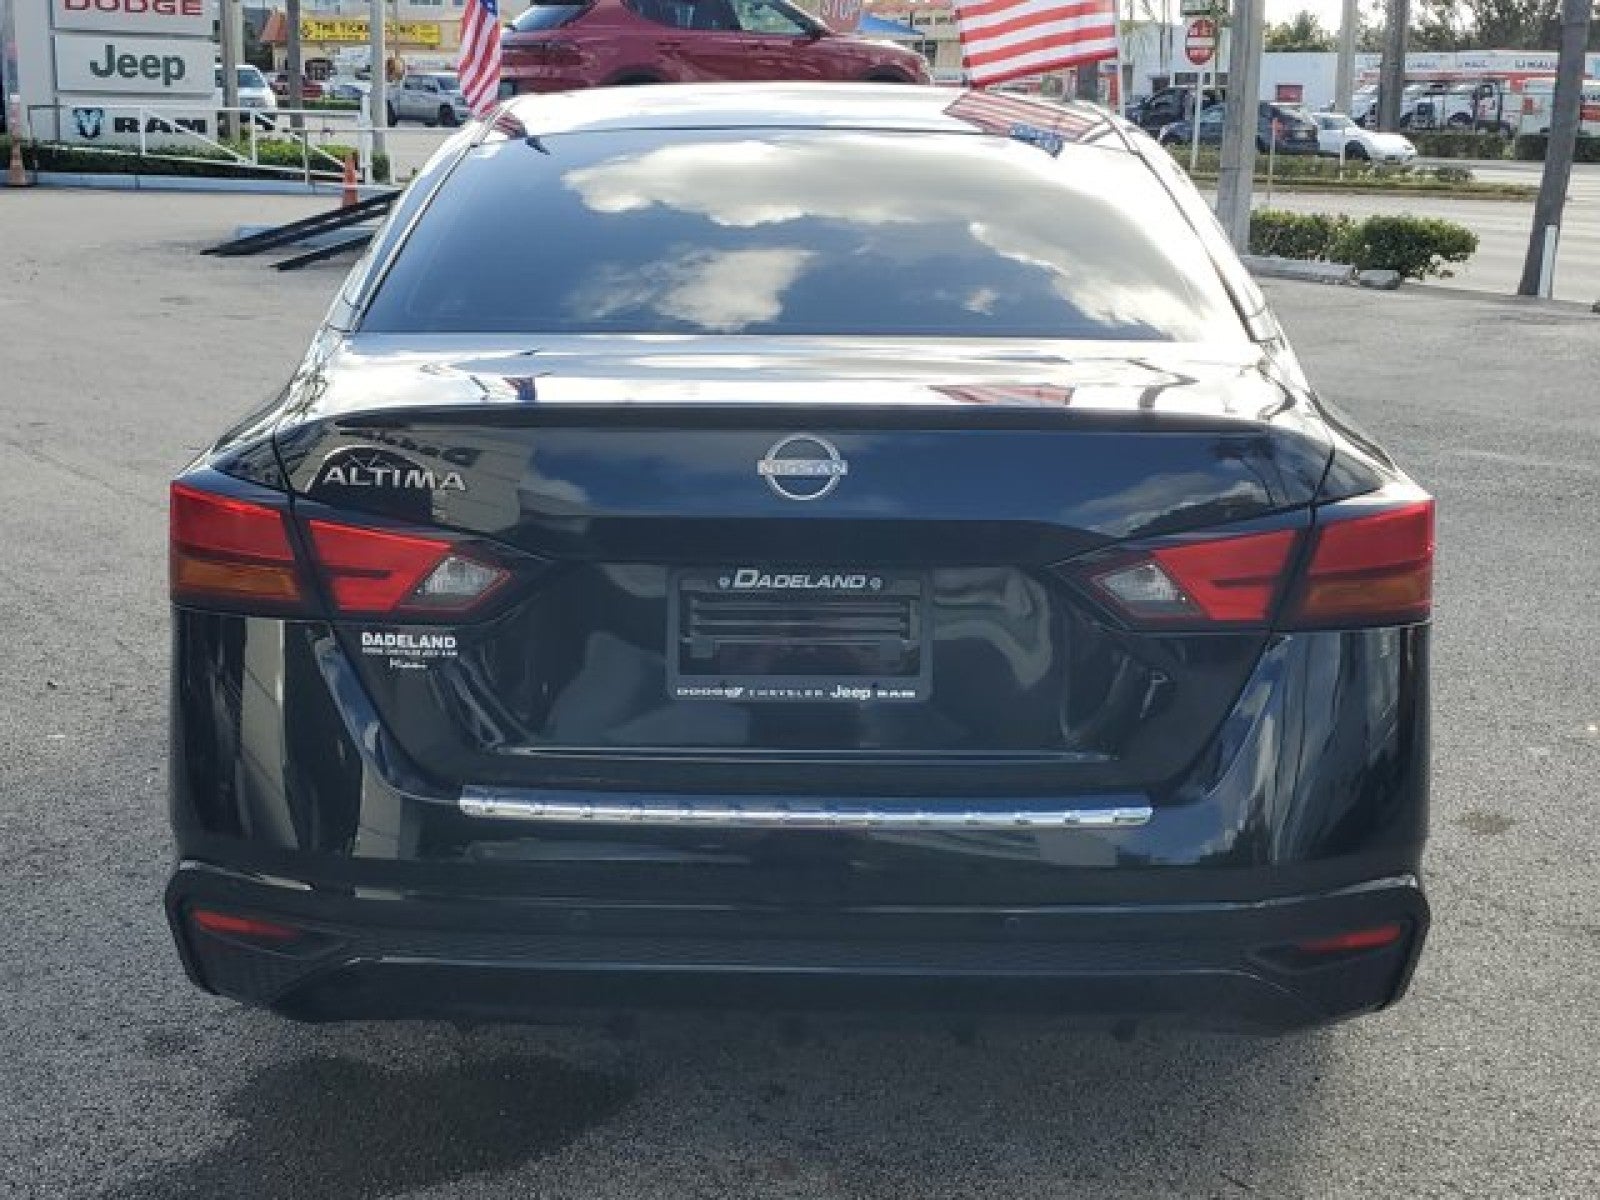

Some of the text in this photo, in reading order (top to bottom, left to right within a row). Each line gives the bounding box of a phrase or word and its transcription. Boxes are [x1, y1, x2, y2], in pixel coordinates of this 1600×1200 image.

[90, 44, 186, 87] Jeep
[114, 117, 207, 133] RAM
[322, 467, 466, 491] ALTIMA
[734, 569, 866, 589] DADELAND
[361, 632, 457, 648] DADELAND
[829, 685, 871, 700] Jeep
